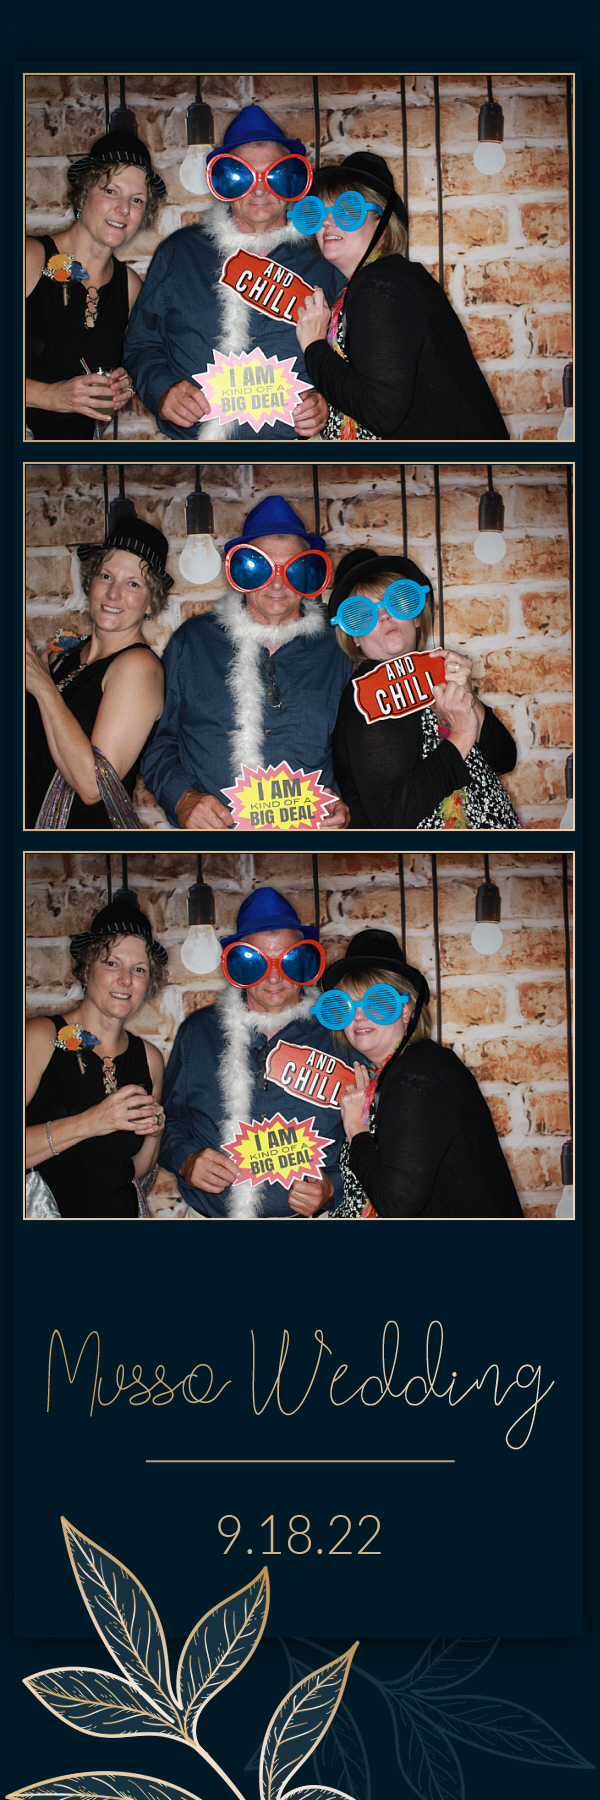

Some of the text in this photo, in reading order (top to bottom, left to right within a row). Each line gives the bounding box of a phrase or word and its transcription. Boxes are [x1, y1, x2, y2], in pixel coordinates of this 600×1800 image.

[263, 262, 294, 288] AND
[235, 269, 297, 321] CHILL
[229, 365, 275, 387] I AM
[221, 392, 288, 413] BIG DEAL
[222, 387, 253, 397] KIND
[256, 385, 274, 393] OF
[385, 656, 416, 681] AND
[257, 778, 302, 801] I AM
[250, 805, 315, 826] BIG DEAL
[251, 801, 281, 810] KIND
[284, 798, 300, 806] OF
[305, 1050, 337, 1074] AND
[280, 1061, 341, 1106] CHILL
[254, 1126, 298, 1151] I AM
[250, 1149, 279, 1160] KIND
[282, 1145, 297, 1153] OF
[250, 1149, 313, 1175] BIG DEAL
